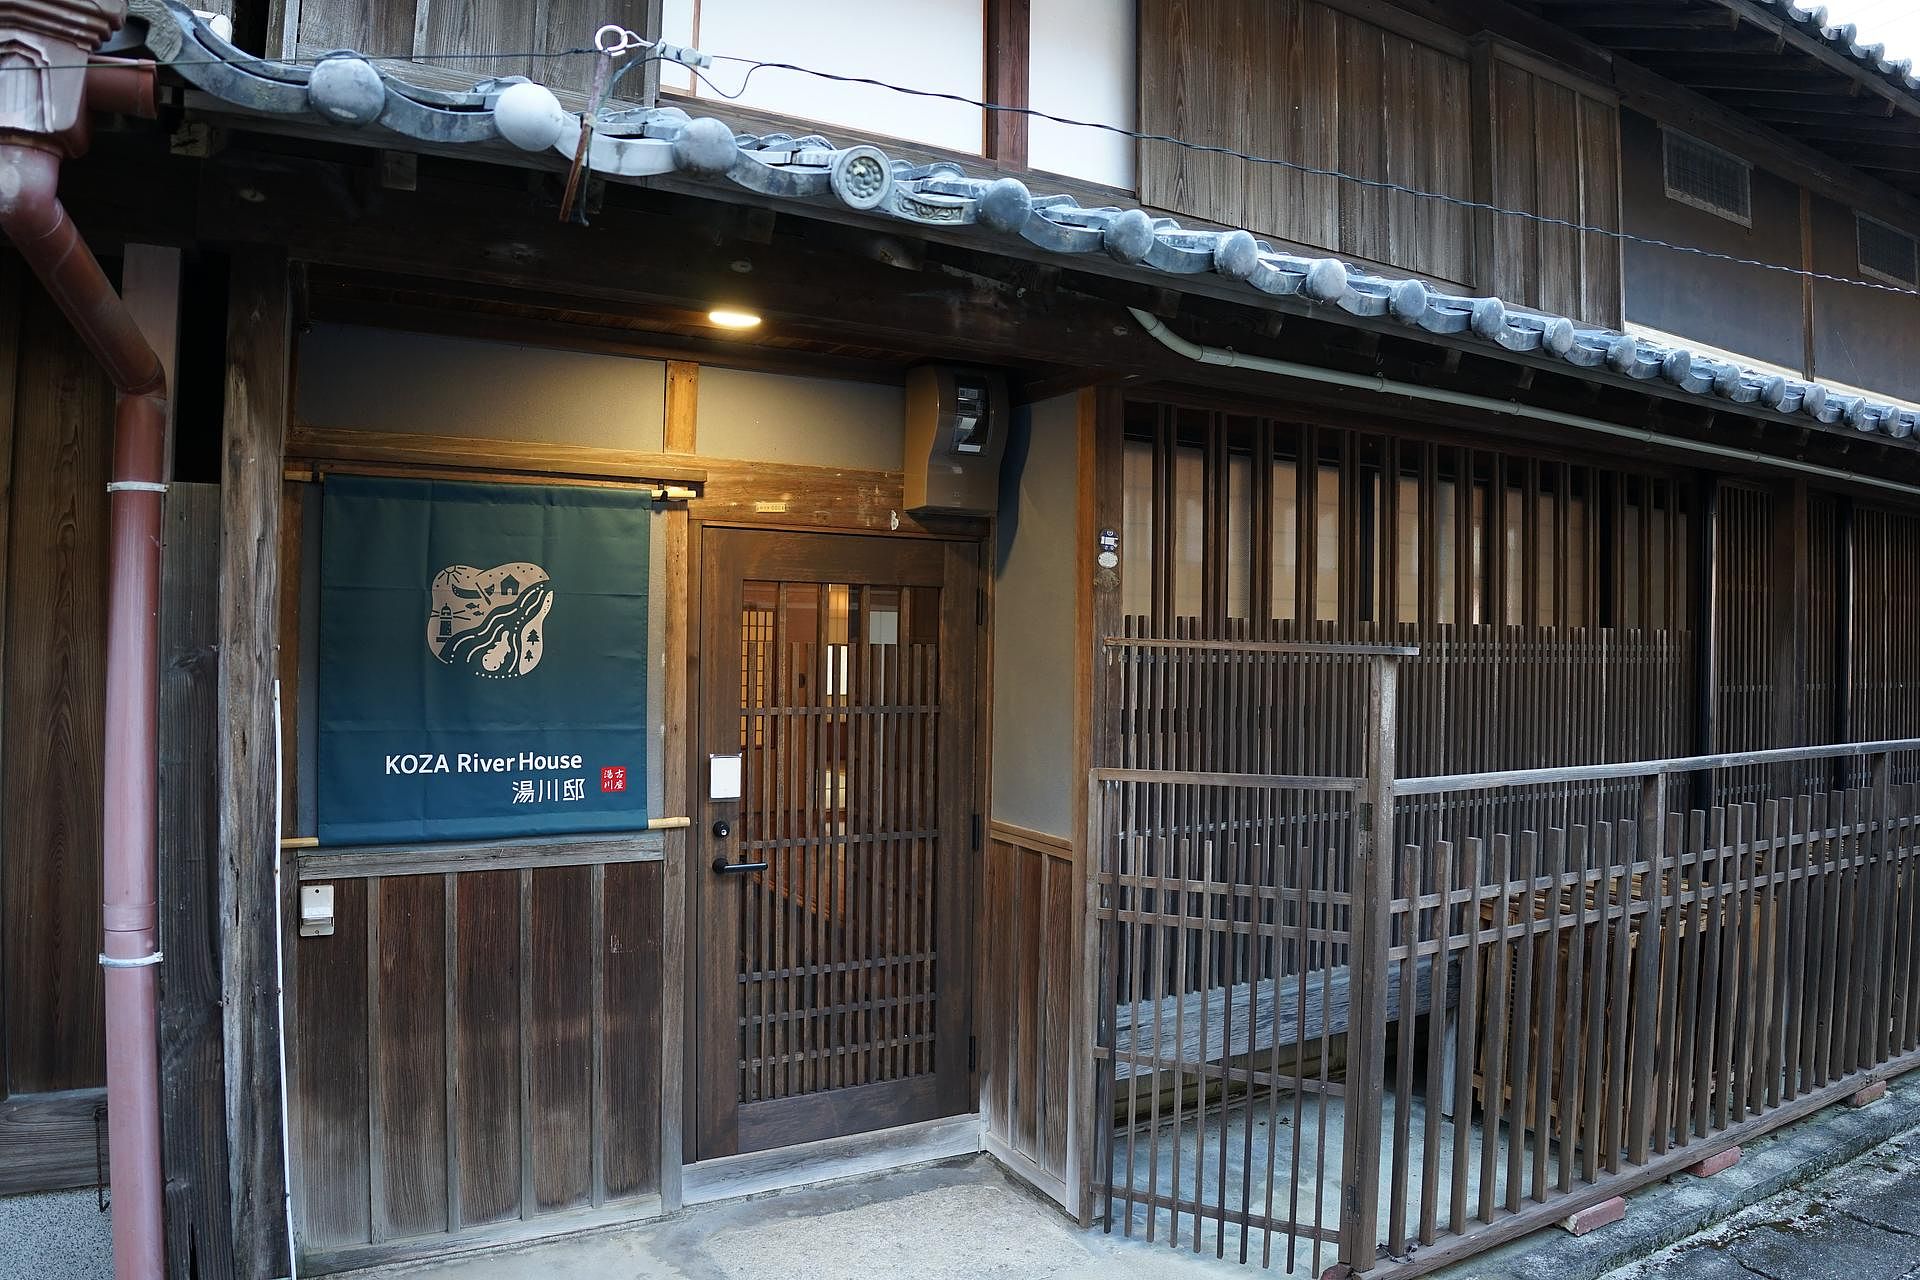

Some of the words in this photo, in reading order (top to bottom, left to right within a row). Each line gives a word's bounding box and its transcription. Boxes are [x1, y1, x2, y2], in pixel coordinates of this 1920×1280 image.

[385, 754, 450, 775] KOZA
[458, 753, 516, 773] River
[519, 751, 583, 771] House
[512, 778, 586, 804] 湯川邸
